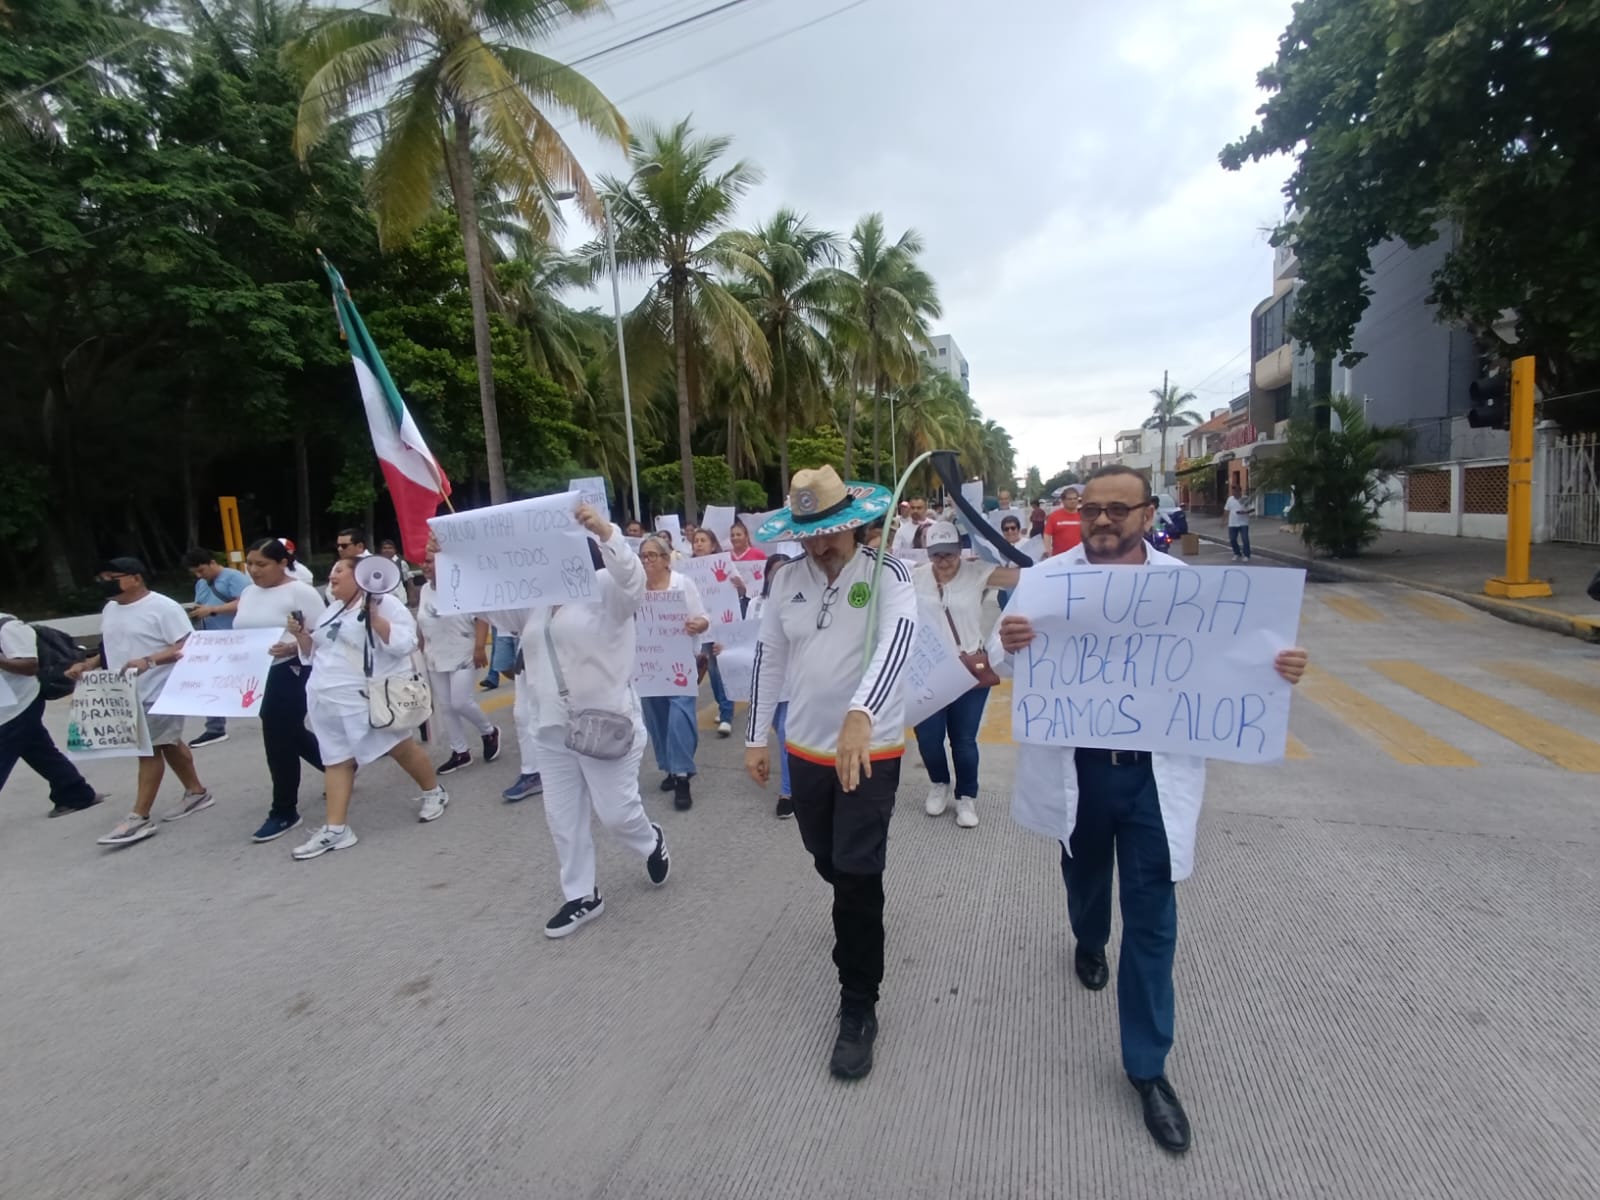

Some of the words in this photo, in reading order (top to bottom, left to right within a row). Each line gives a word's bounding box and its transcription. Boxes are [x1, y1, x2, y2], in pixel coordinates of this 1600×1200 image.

[437, 520, 477, 544] SALUD
[479, 513, 516, 537] PARA
[524, 508, 571, 534] TODOS
[477, 553, 499, 571] EN
[503, 547, 550, 568] TODOS
[481, 578, 543, 607] LADOS
[1045, 569, 1251, 635] FUERA
[1028, 631, 1194, 690] ROBERTO
[1017, 693, 1142, 742] RAMOS
